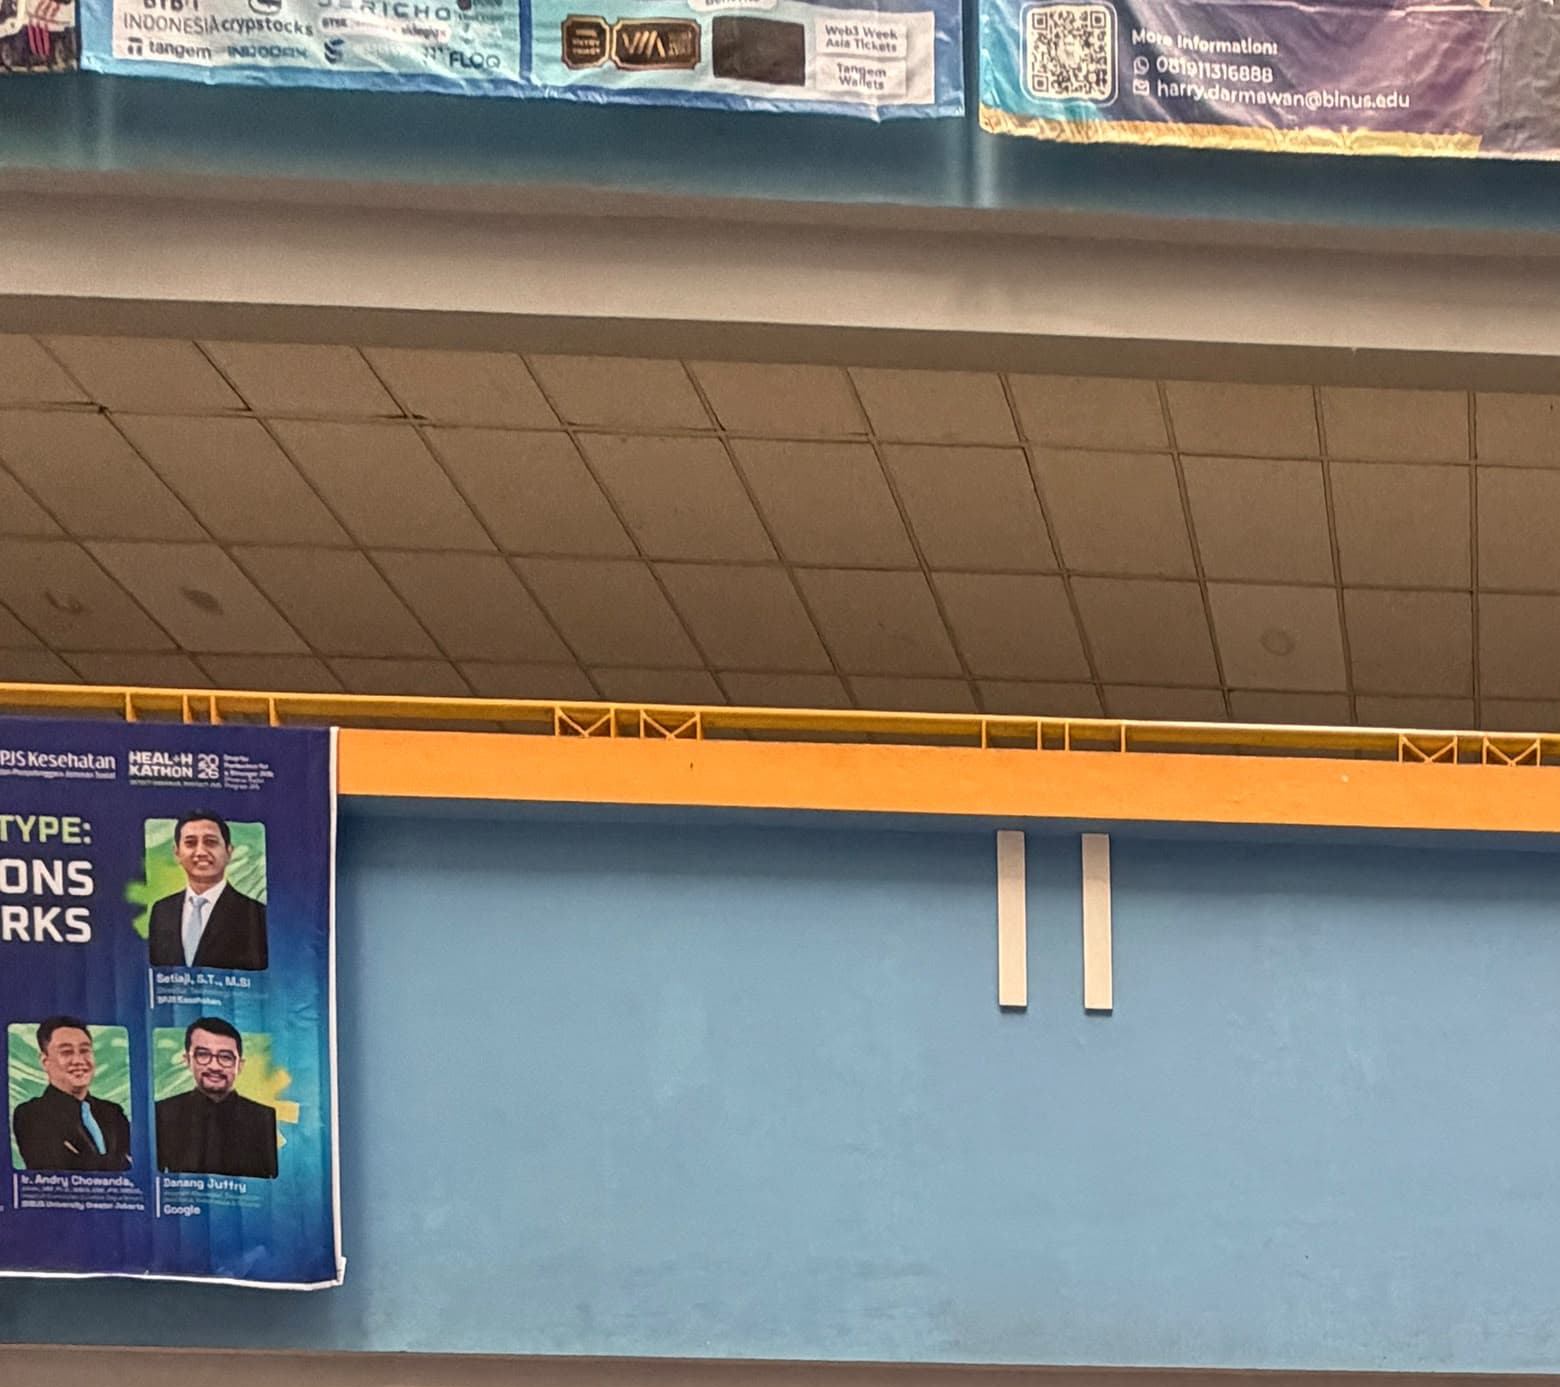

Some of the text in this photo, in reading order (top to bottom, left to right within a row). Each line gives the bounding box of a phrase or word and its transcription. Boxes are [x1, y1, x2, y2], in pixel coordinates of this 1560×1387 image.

[124, 12, 219, 34] INDONESIA
[221, 16, 314, 36] crypstocks
[825, 24, 898, 40] Web3 Week
[1132, 29, 1172, 47] More
[149, 37, 212, 60] tangem
[825, 37, 898, 53] Asia Tickets
[836, 62, 888, 79] Tangem
[838, 76, 886, 92] Wallets
[27, 750, 116, 770] Kesehatan
[128, 764, 193, 778] KATHON
[0, 813, 92, 845] TYPE:
[0, 858, 94, 897] ONS
[1, 905, 92, 943] RKS
[35, 1175, 69, 1188] Andry
[163, 1177, 204, 1190] Danang
[163, 1204, 201, 1217] Google
